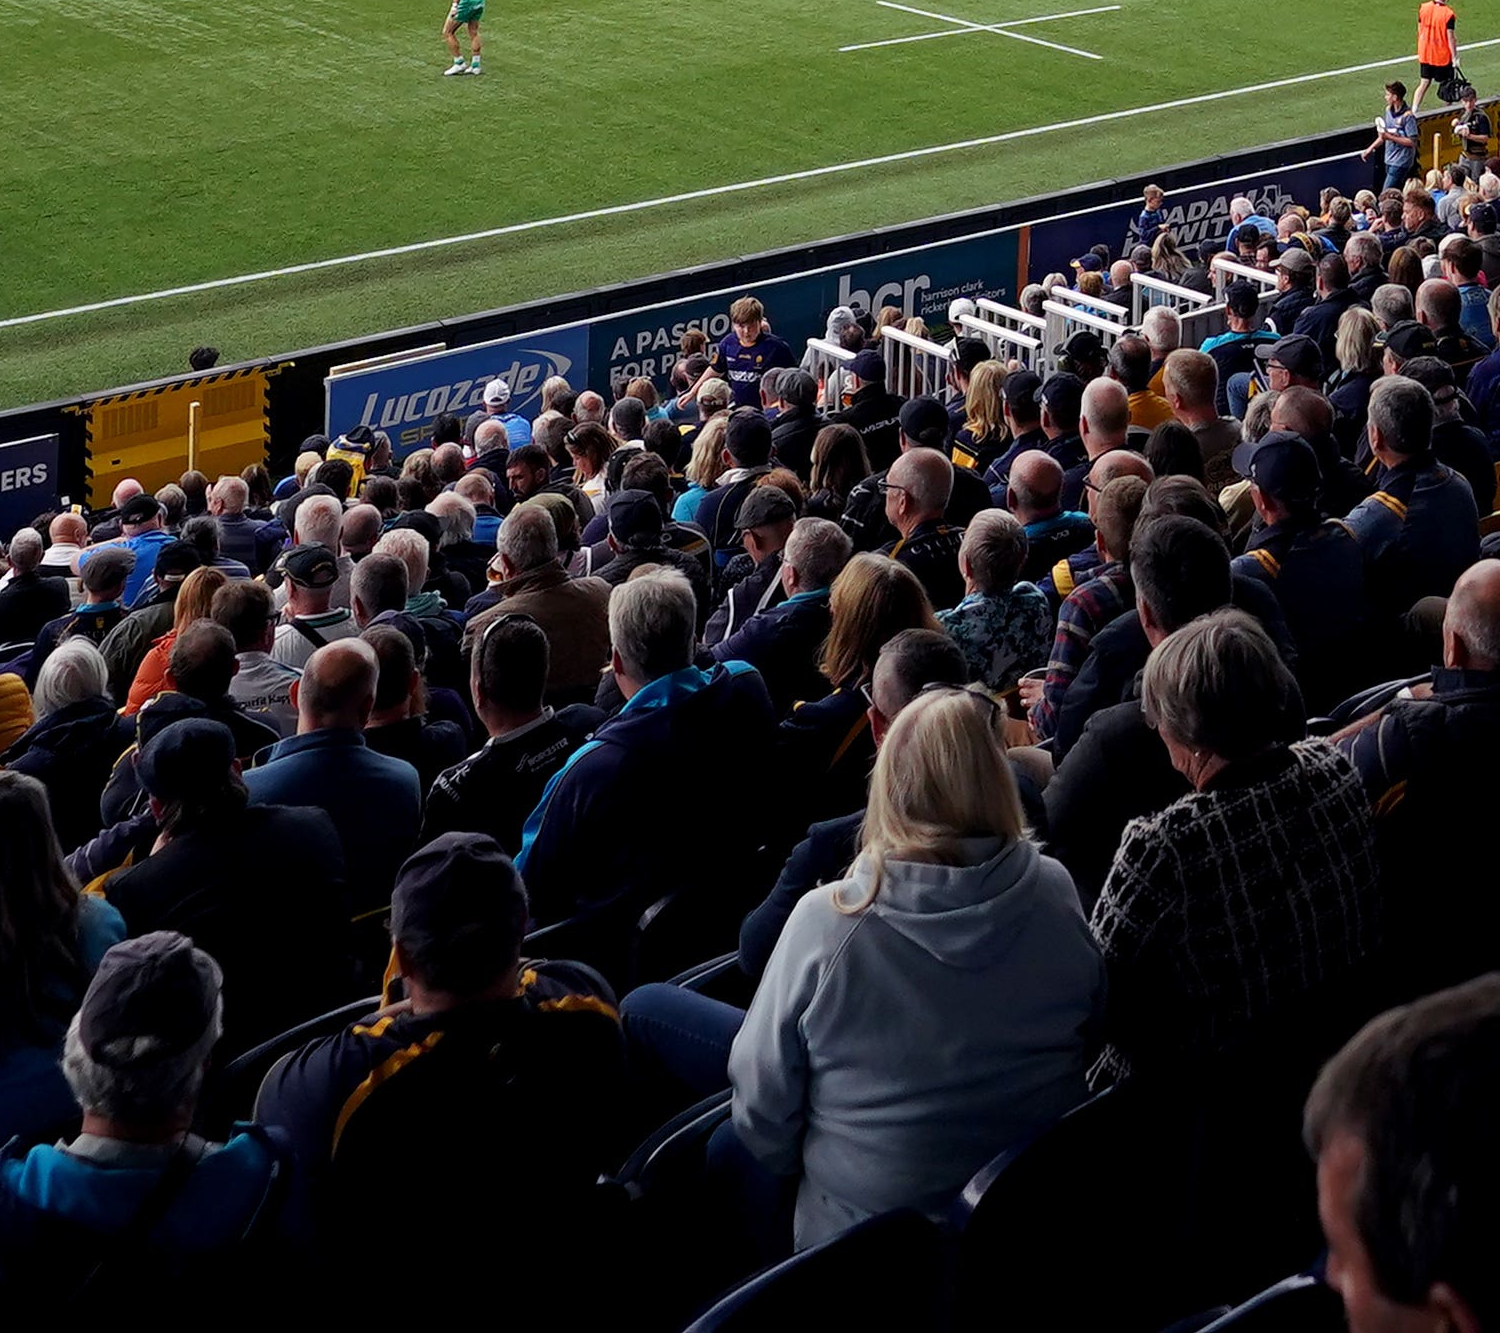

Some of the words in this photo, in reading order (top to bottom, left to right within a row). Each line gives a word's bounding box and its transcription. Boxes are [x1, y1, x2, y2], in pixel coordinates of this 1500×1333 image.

[921, 285, 958, 303] harrison
[960, 280, 985, 295] clark
[610, 337, 630, 360] A
[636, 313, 730, 351] PASSIO
[609, 358, 655, 385] FOR
